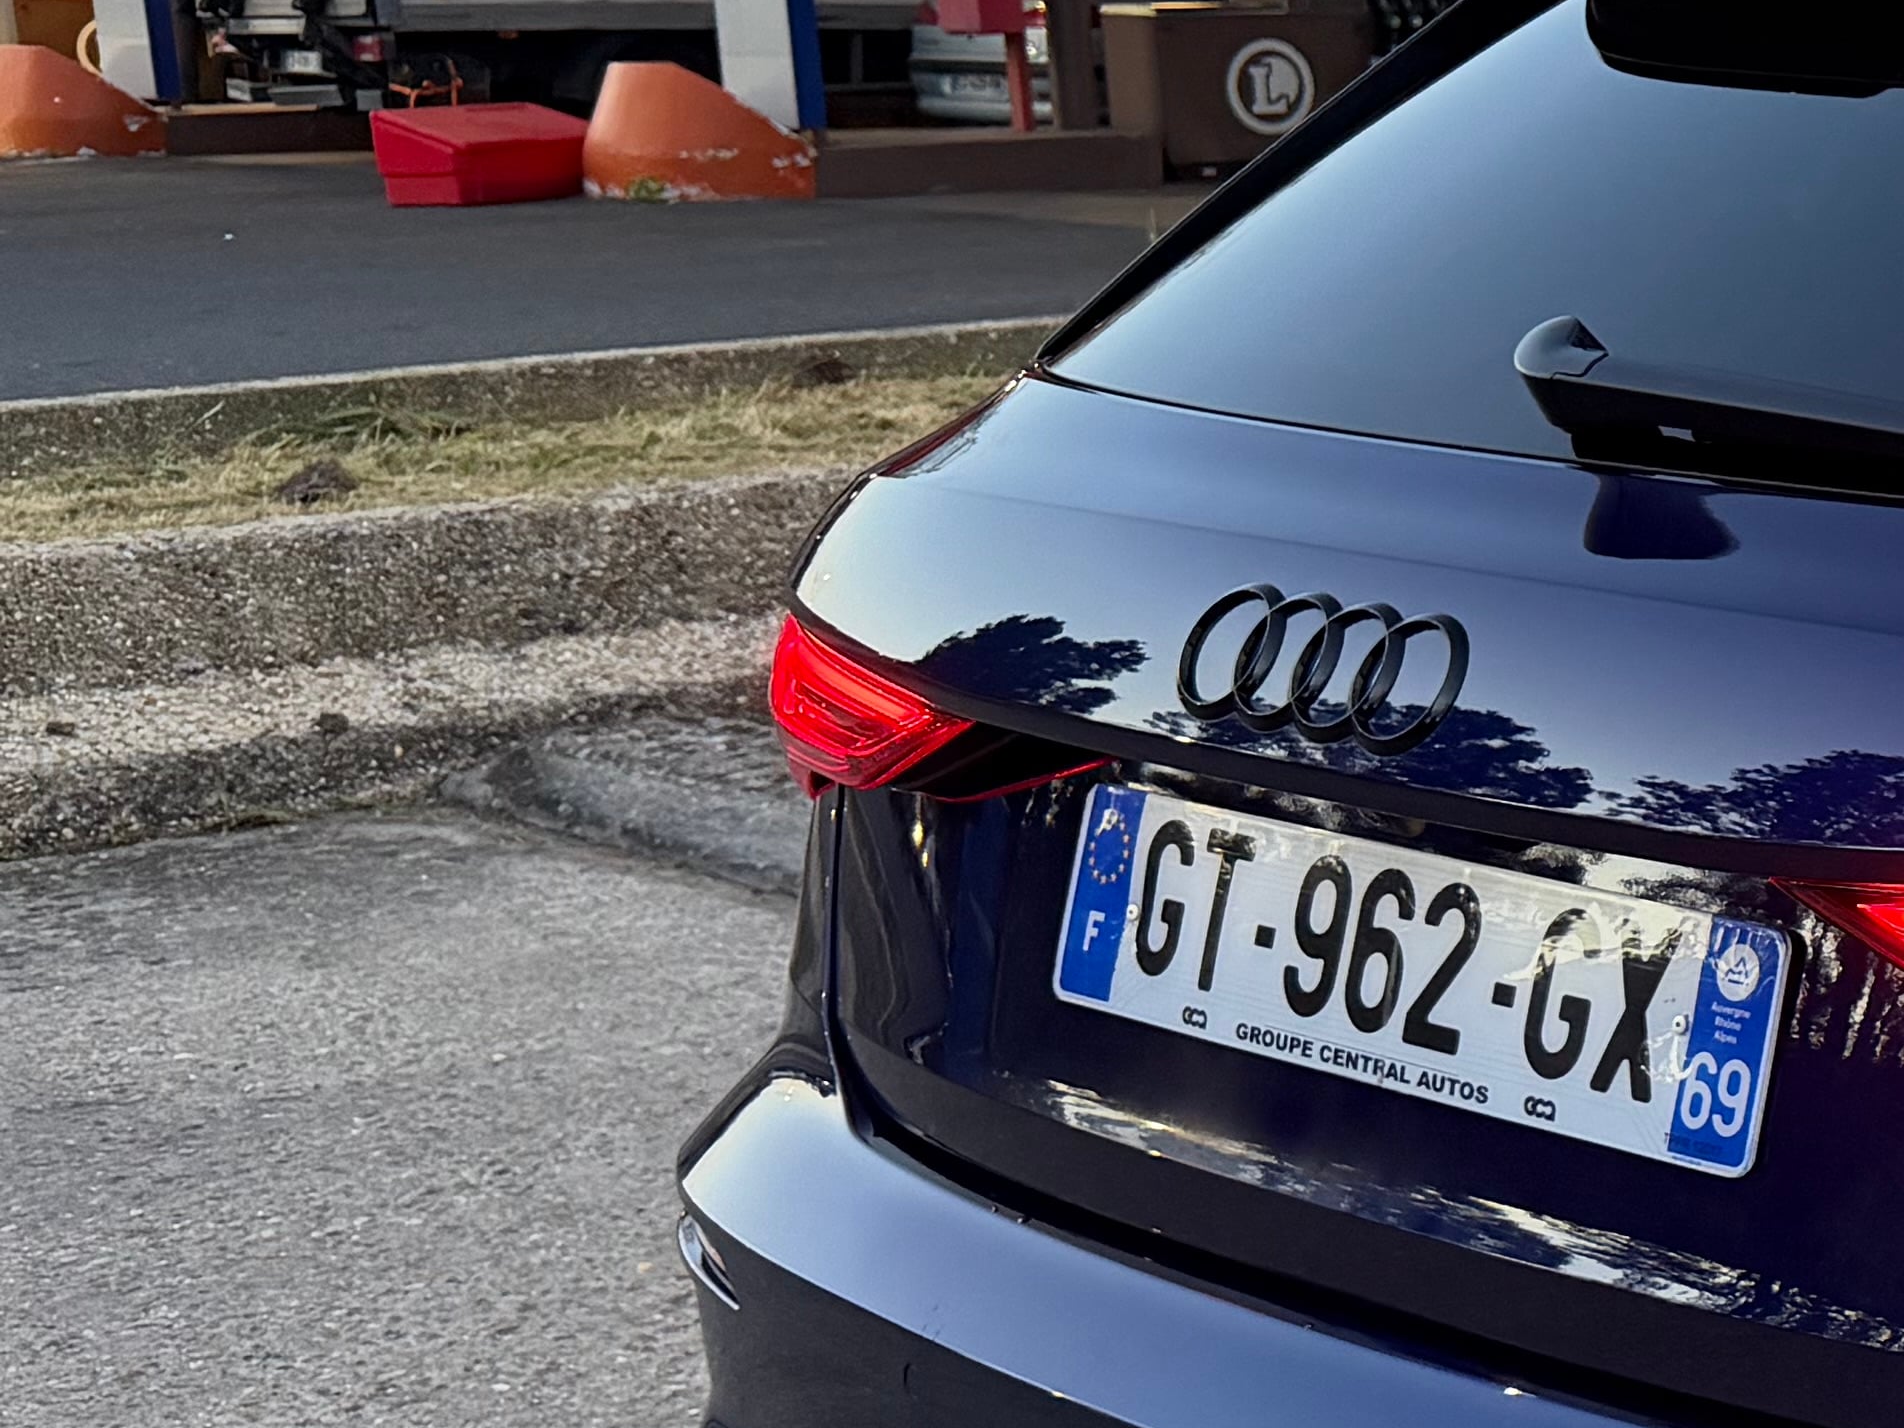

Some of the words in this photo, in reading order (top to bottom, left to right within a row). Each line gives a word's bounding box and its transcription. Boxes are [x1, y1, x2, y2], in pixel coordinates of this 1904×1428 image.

[1082, 910, 1106, 952] F
[1136, 819, 1683, 1103] GT-962-GX
[1235, 1021, 1314, 1059] GROUPE
[1319, 1044, 1412, 1085] CENTRAL
[1415, 1070, 1490, 1105] AUTOS
[1680, 1051, 1751, 1138] 69
